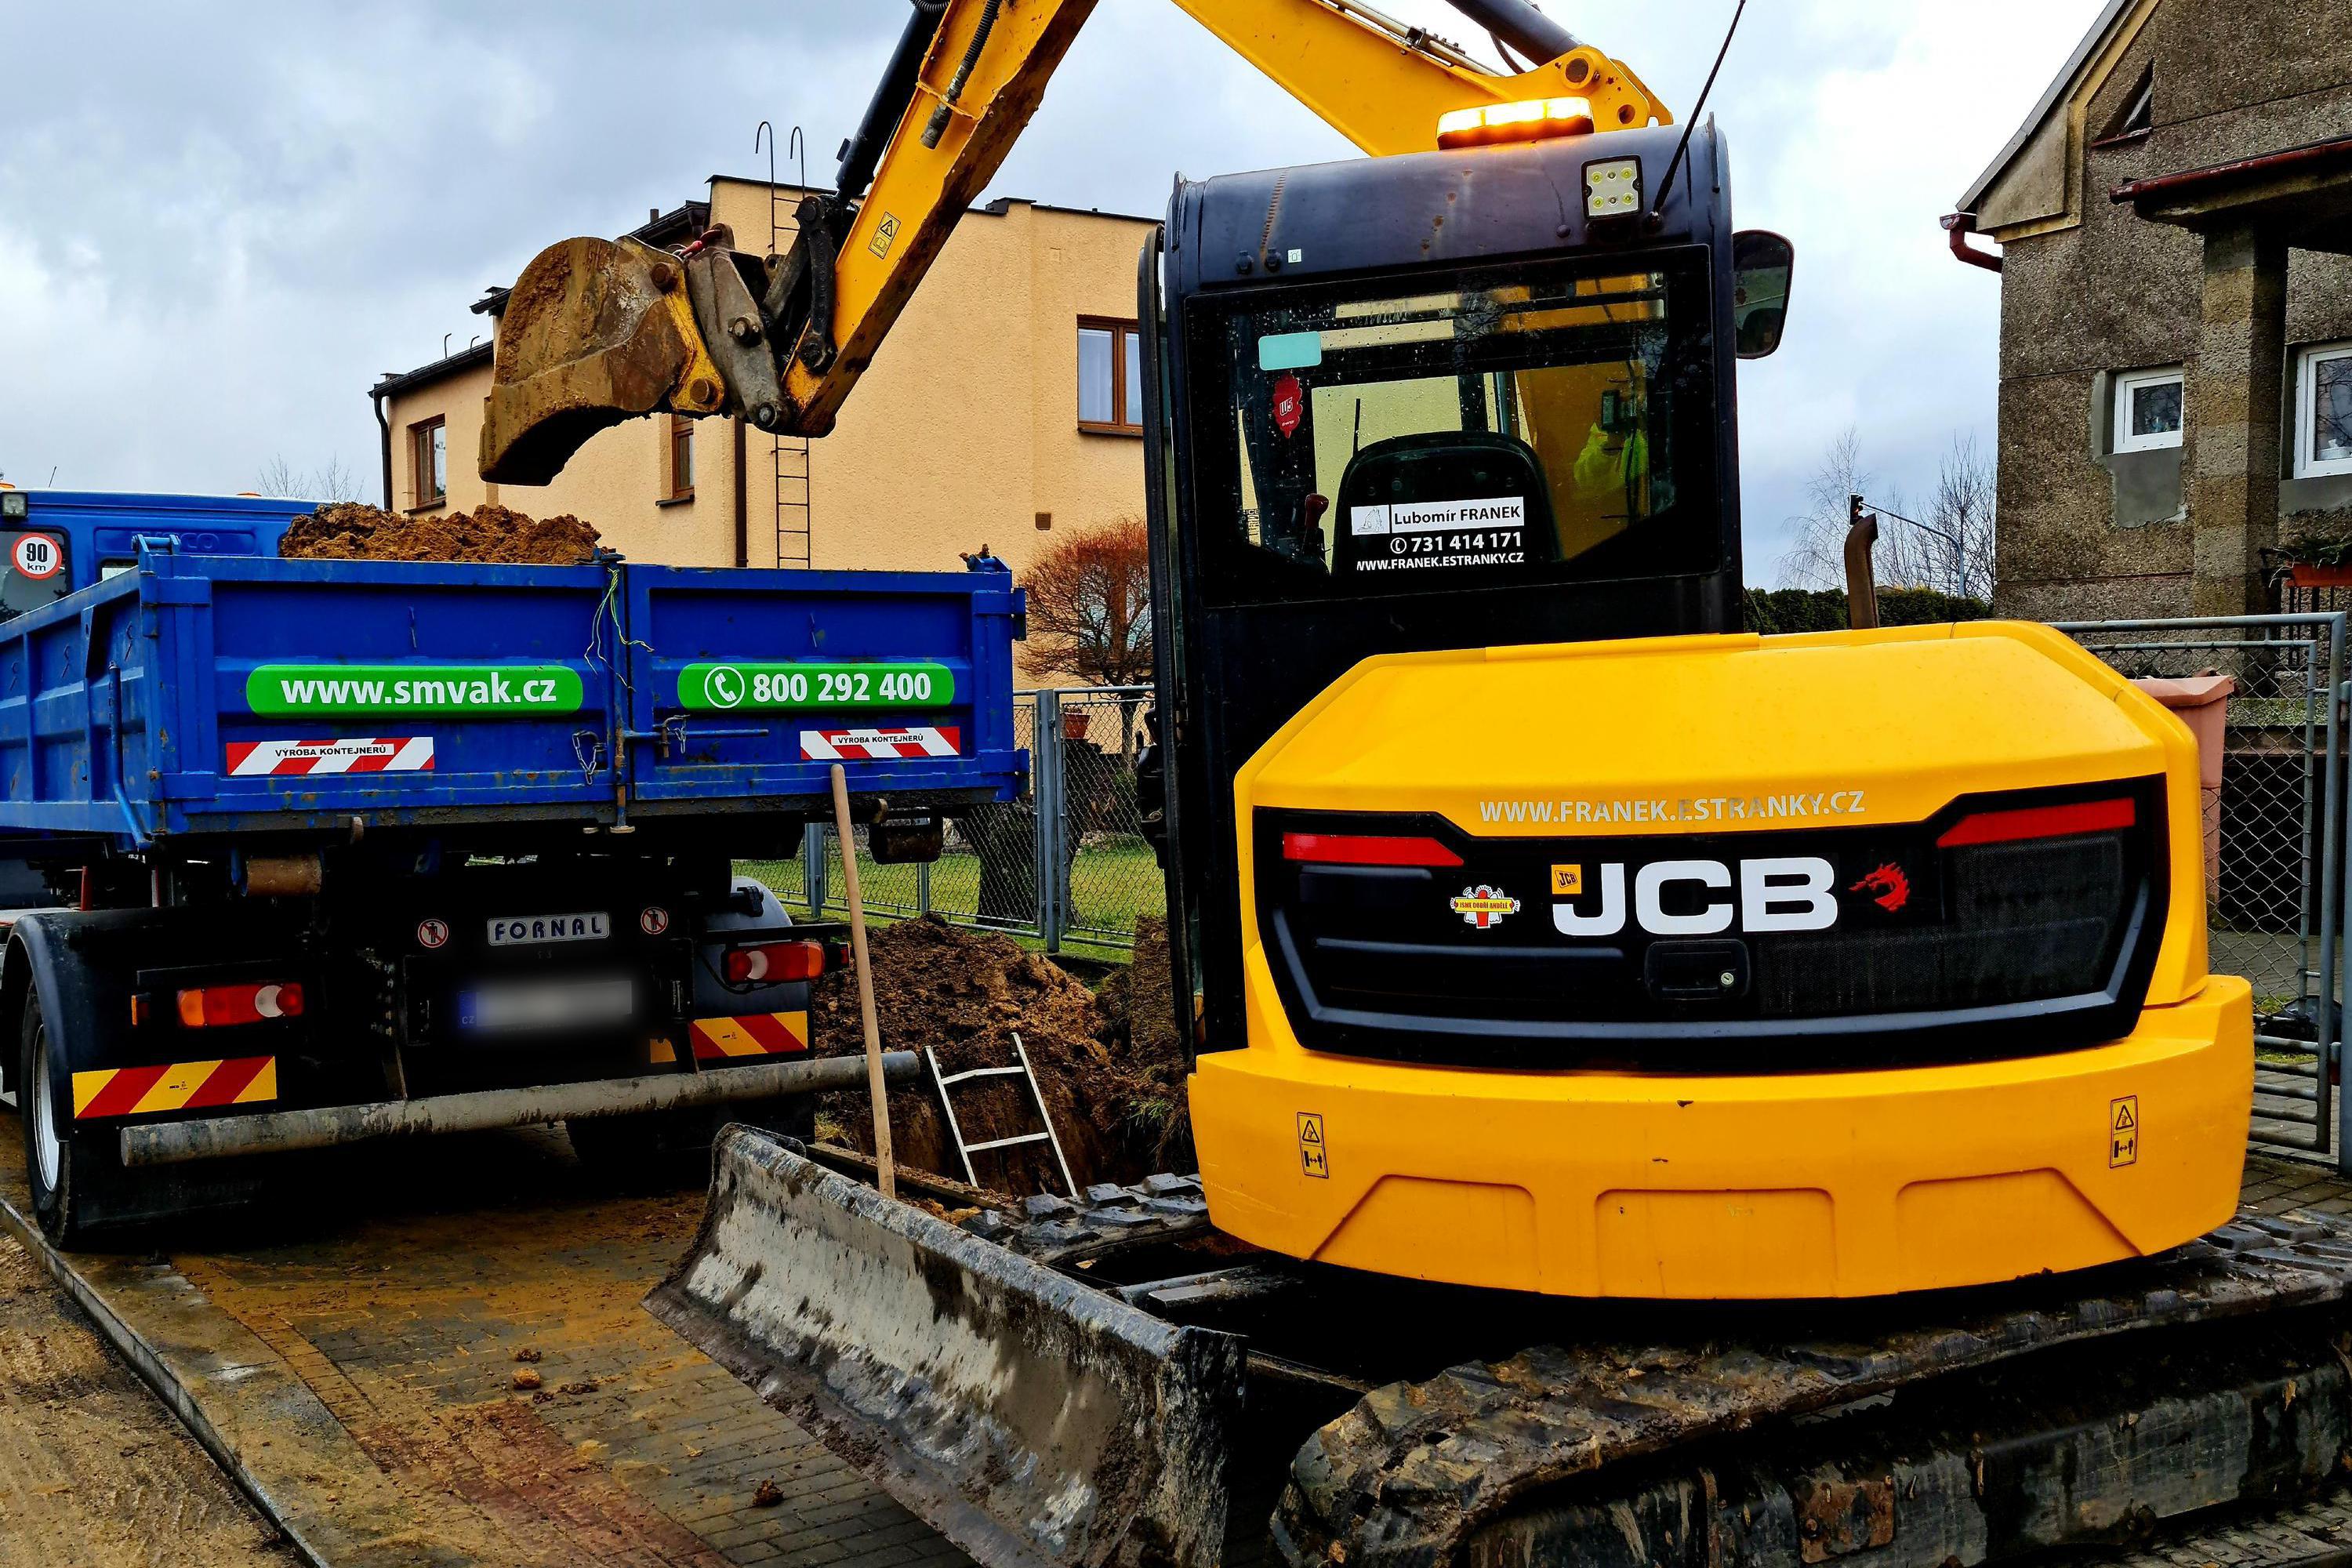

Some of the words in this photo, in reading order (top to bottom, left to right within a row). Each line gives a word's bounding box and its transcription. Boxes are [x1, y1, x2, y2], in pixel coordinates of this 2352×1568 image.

[1394, 510, 1456, 525] Lubomír
[1460, 506, 1521, 521] FRANEK
[26, 543, 48, 562] 90
[1411, 536, 1443, 553] 731
[1450, 534, 1485, 550] 414
[1490, 532, 1521, 548] 171
[281, 672, 557, 704] www.smvak.cz
[753, 673, 808, 702] 800
[818, 673, 870, 702] 292
[879, 672, 931, 701] 400
[872, 734, 924, 743] KONTEJNERŮ
[275, 748, 317, 757] VÝROBA
[320, 745, 387, 756] KONTEJNERŮ
[1479, 790, 1865, 822] WWW.FRANEK.ESTRANKY.CZ
[1559, 872, 1576, 886] JCB
[1552, 857, 1838, 936] JCB
[495, 916, 602, 941] FORNAL
